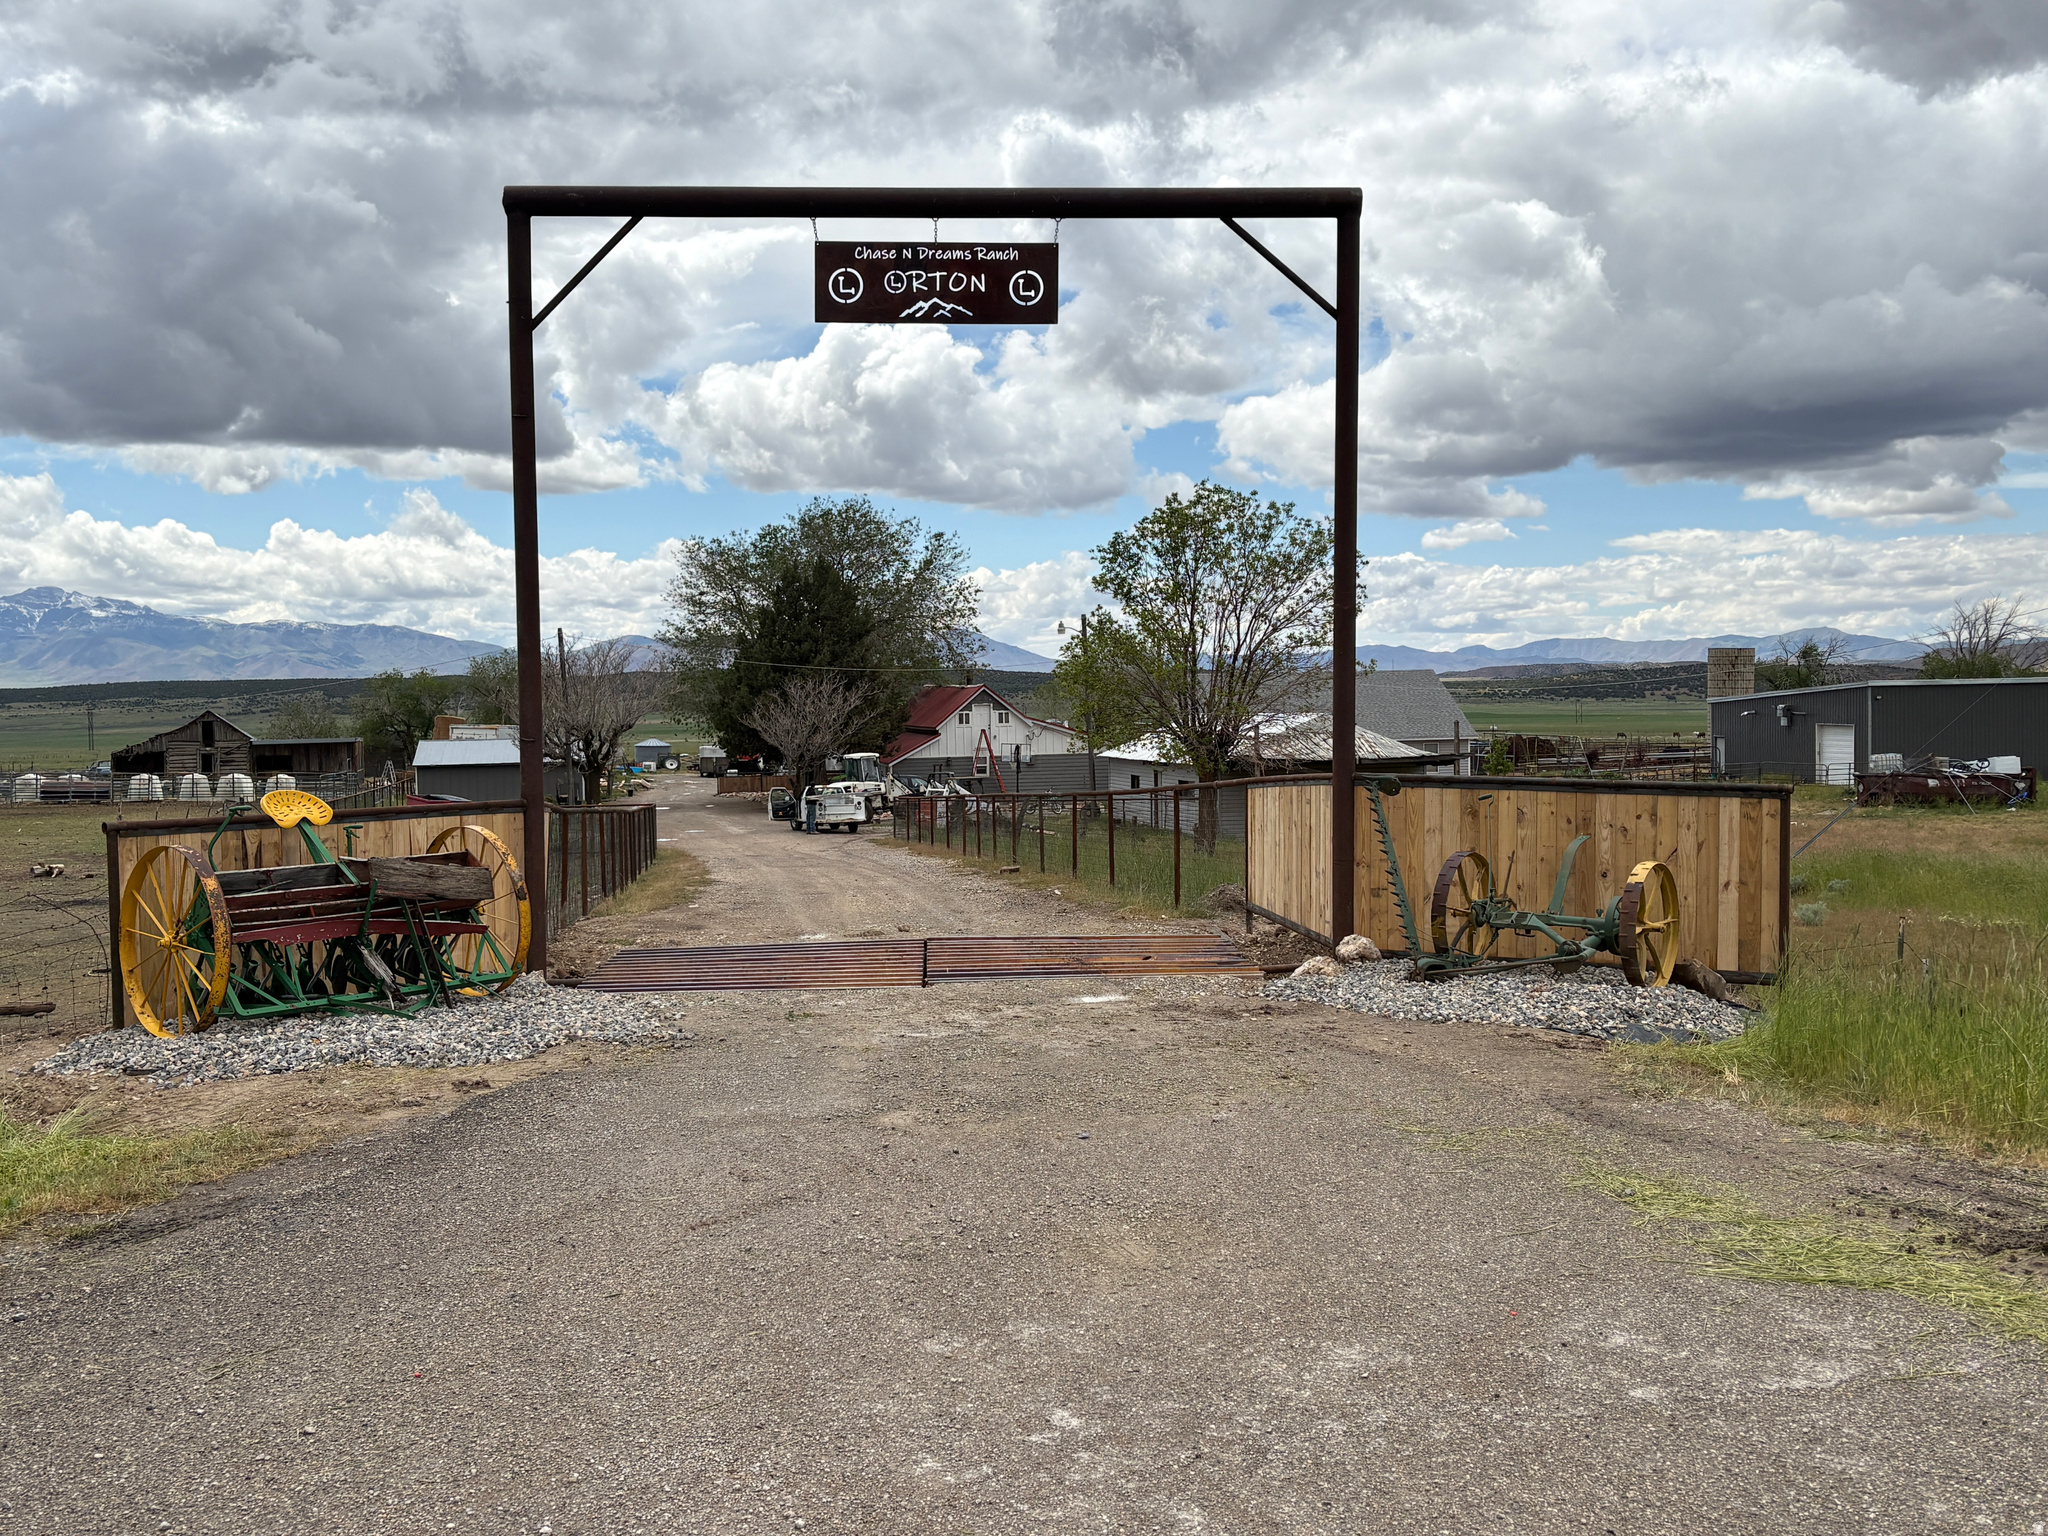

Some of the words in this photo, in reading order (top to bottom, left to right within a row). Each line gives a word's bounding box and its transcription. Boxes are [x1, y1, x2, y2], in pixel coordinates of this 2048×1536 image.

[854, 246, 896, 260] Chase
[902, 248, 912, 259] N
[917, 246, 972, 260] Dreams
[974, 246, 1019, 261] Ranch
